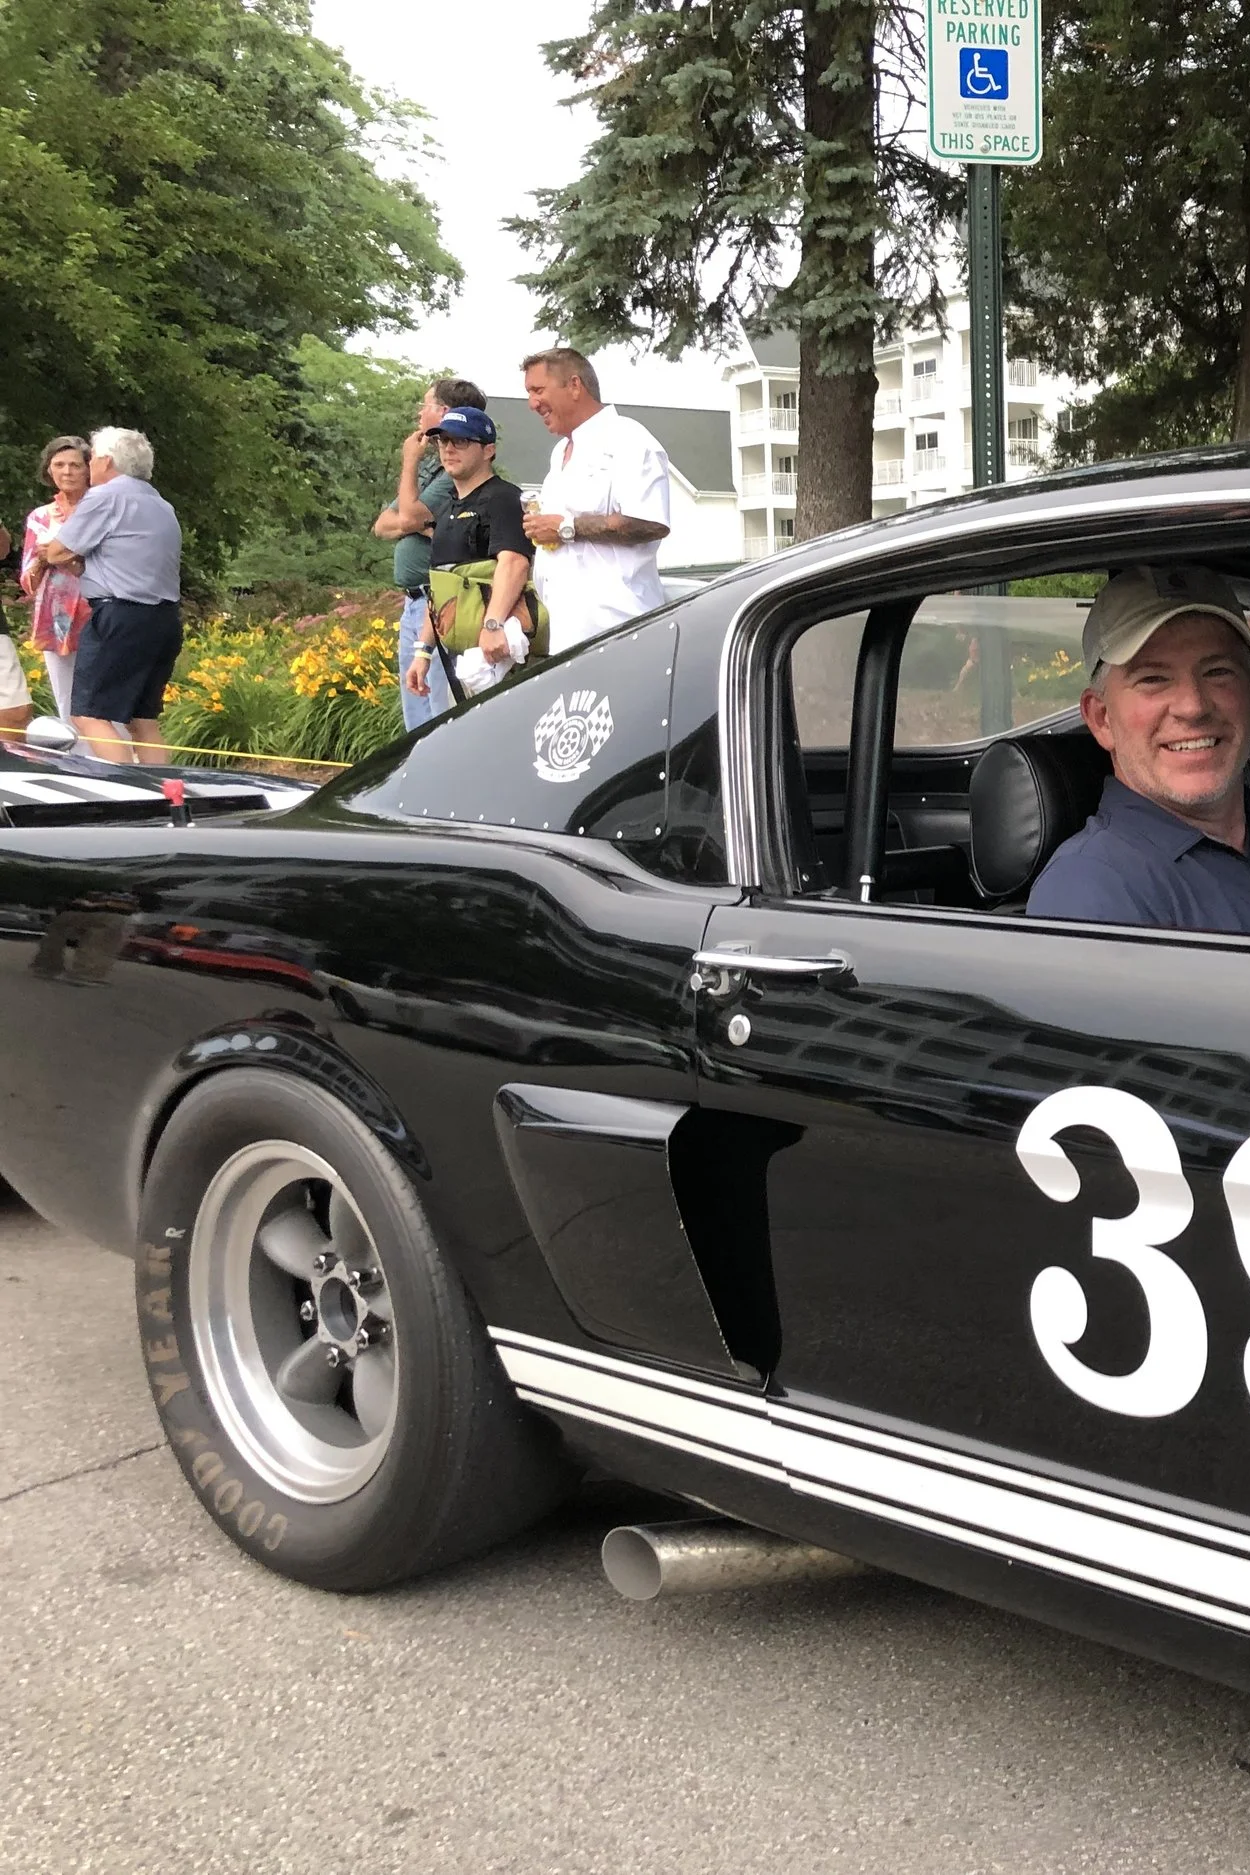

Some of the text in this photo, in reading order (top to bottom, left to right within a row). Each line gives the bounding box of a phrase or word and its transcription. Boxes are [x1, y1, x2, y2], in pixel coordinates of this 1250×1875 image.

[937, 0, 1028, 19] RESERVED
[946, 21, 1021, 46] PARKING
[940, 132, 1030, 152] THIS SPACE
